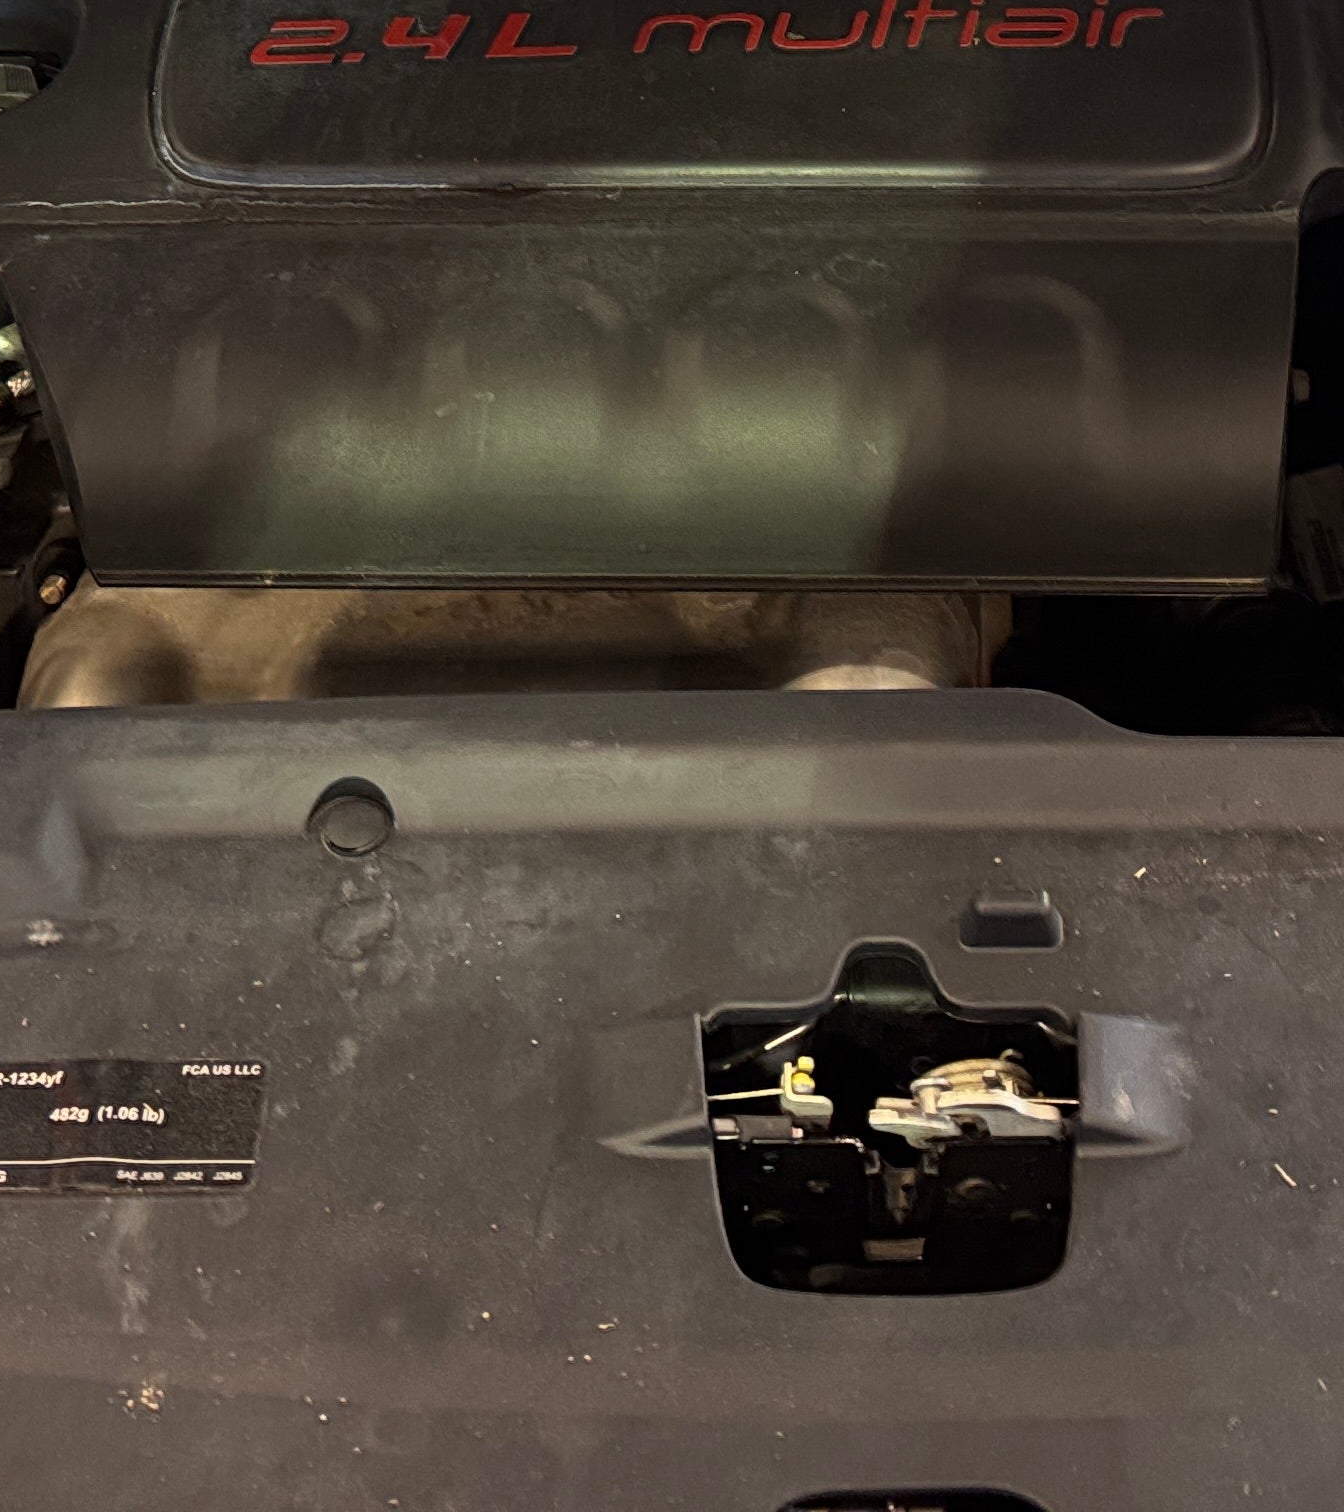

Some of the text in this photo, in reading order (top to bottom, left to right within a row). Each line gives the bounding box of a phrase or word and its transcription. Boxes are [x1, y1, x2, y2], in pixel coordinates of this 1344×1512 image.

[181, 1064, 262, 1076] FCA US LLC
[49, 1103, 165, 1125] 482g (1.06 lb)
[116, 1169, 138, 1181] SAE
